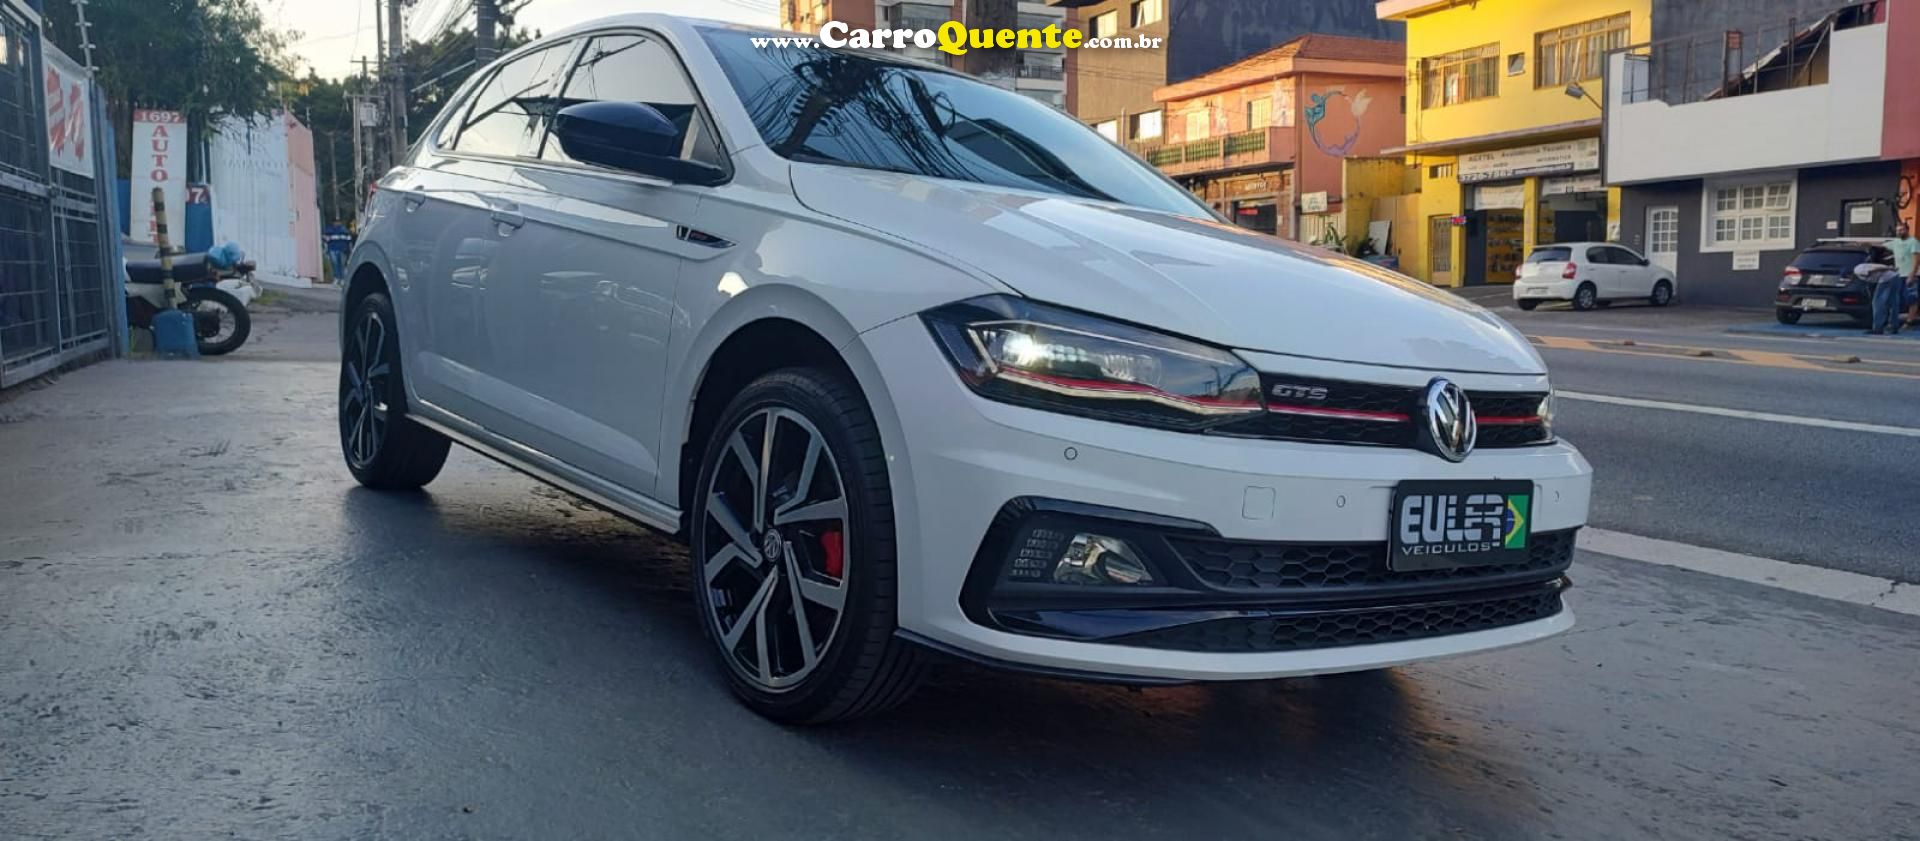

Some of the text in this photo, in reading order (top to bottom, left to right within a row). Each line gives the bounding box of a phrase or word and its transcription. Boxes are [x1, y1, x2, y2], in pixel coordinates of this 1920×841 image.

[141, 112, 182, 123] 1697
[150, 125, 169, 183] AUTO
[1271, 383, 1328, 400] GTS
[1401, 494, 1505, 547] EULER
[1402, 542, 1491, 556] VEICULOS
